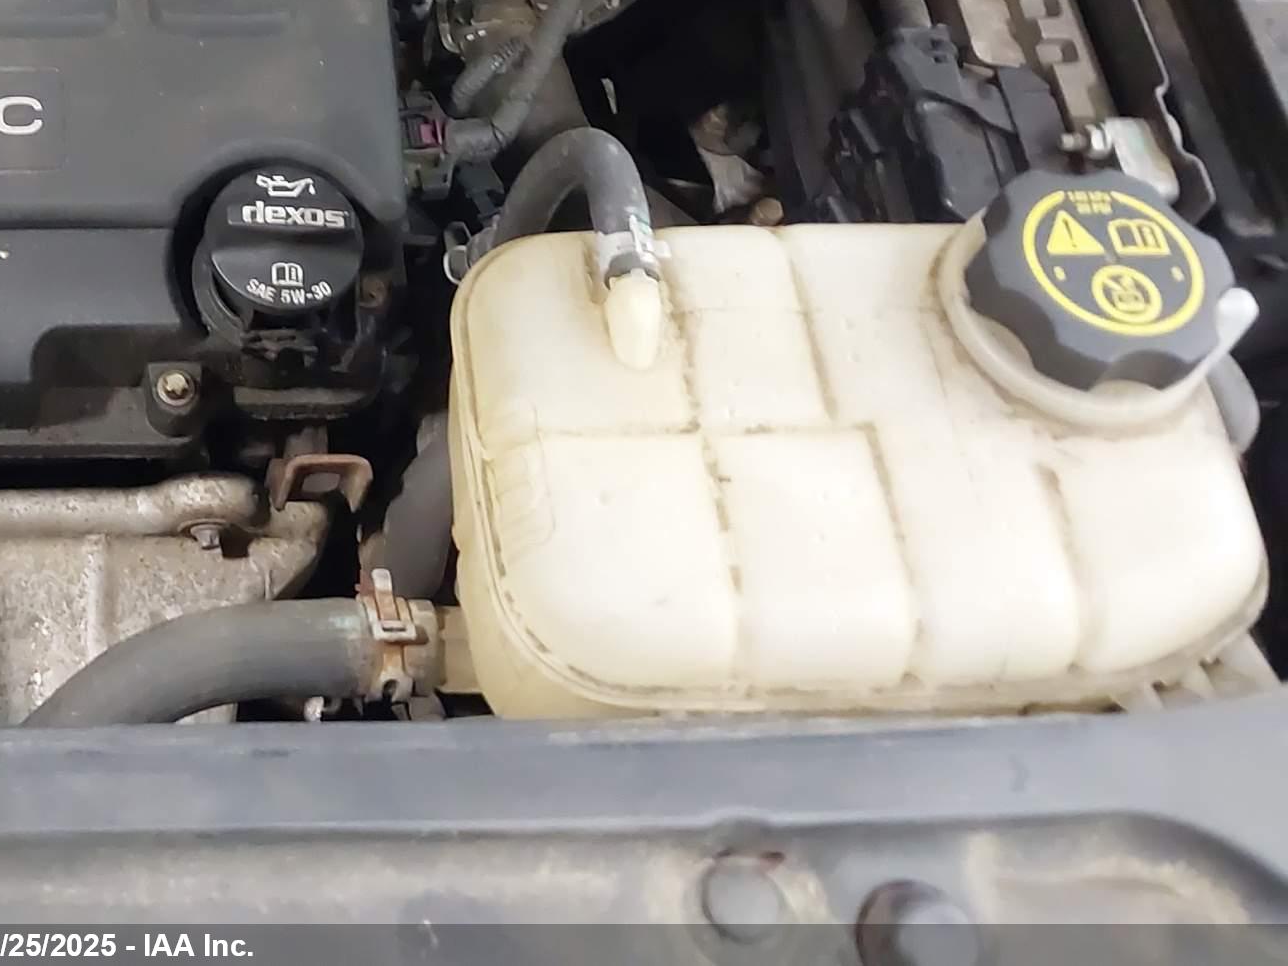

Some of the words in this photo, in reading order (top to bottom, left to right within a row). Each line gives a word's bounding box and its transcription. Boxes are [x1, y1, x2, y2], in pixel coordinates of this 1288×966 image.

[242, 200, 345, 228] dexos
[246, 278, 277, 303] SAE
[280, 281, 332, 305] 5W-30
